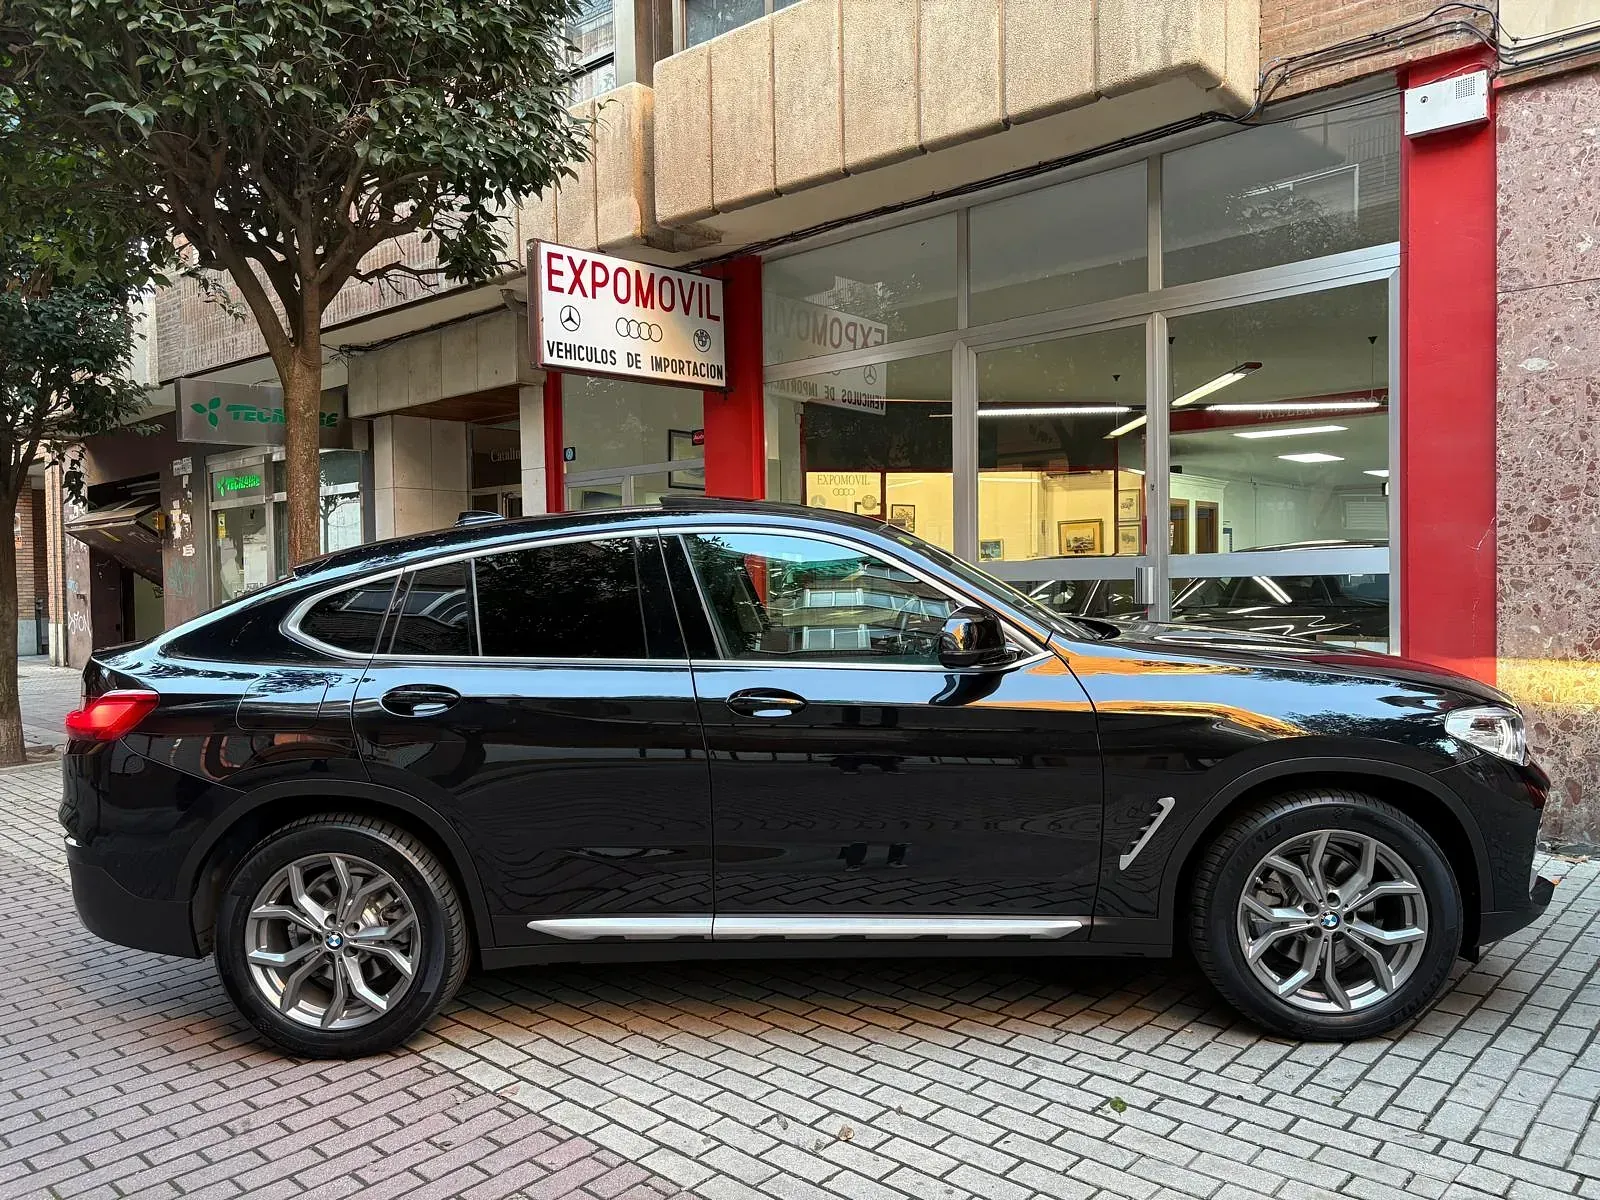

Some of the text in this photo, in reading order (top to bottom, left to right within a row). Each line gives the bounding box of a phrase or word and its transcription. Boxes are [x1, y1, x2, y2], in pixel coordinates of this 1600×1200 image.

[547, 251, 721, 322] EXPOMOVIL
[547, 340, 723, 380] VEHICULOS DE IMPORTACION
[817, 474, 870, 486] EXPOMOVIL
